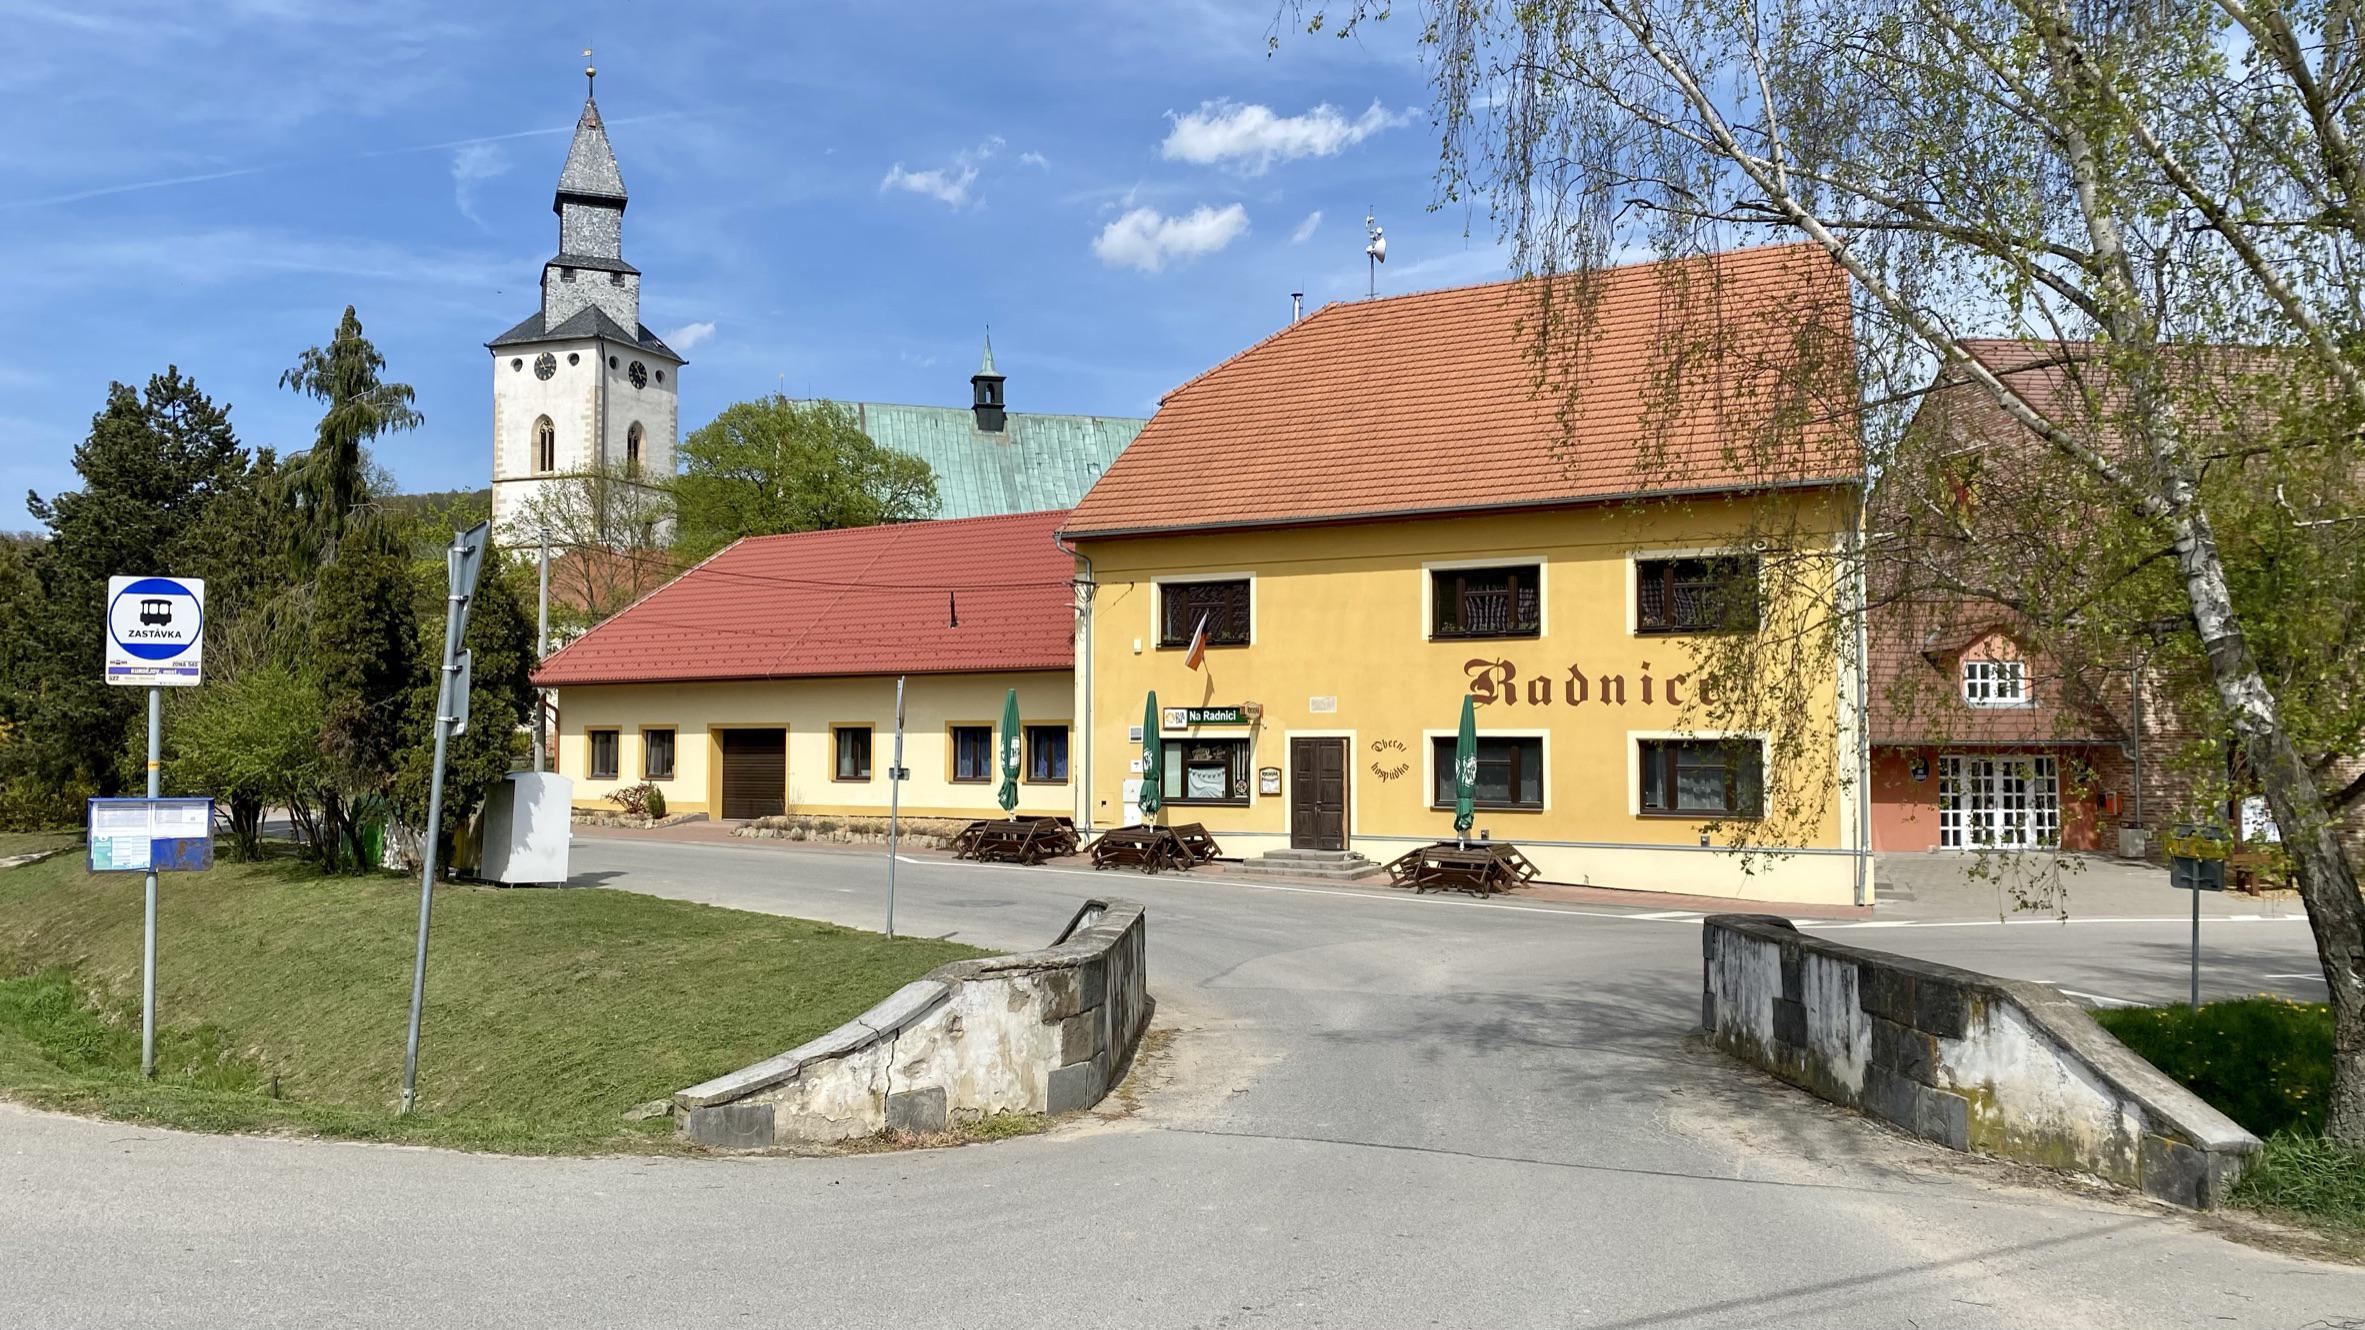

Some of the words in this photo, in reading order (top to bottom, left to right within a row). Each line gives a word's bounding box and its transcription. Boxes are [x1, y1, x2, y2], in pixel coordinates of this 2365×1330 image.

[128, 628, 181, 639] ZASTÁVKA
[1189, 710, 1201, 721] Na
[1203, 710, 1236, 721] Radnici
